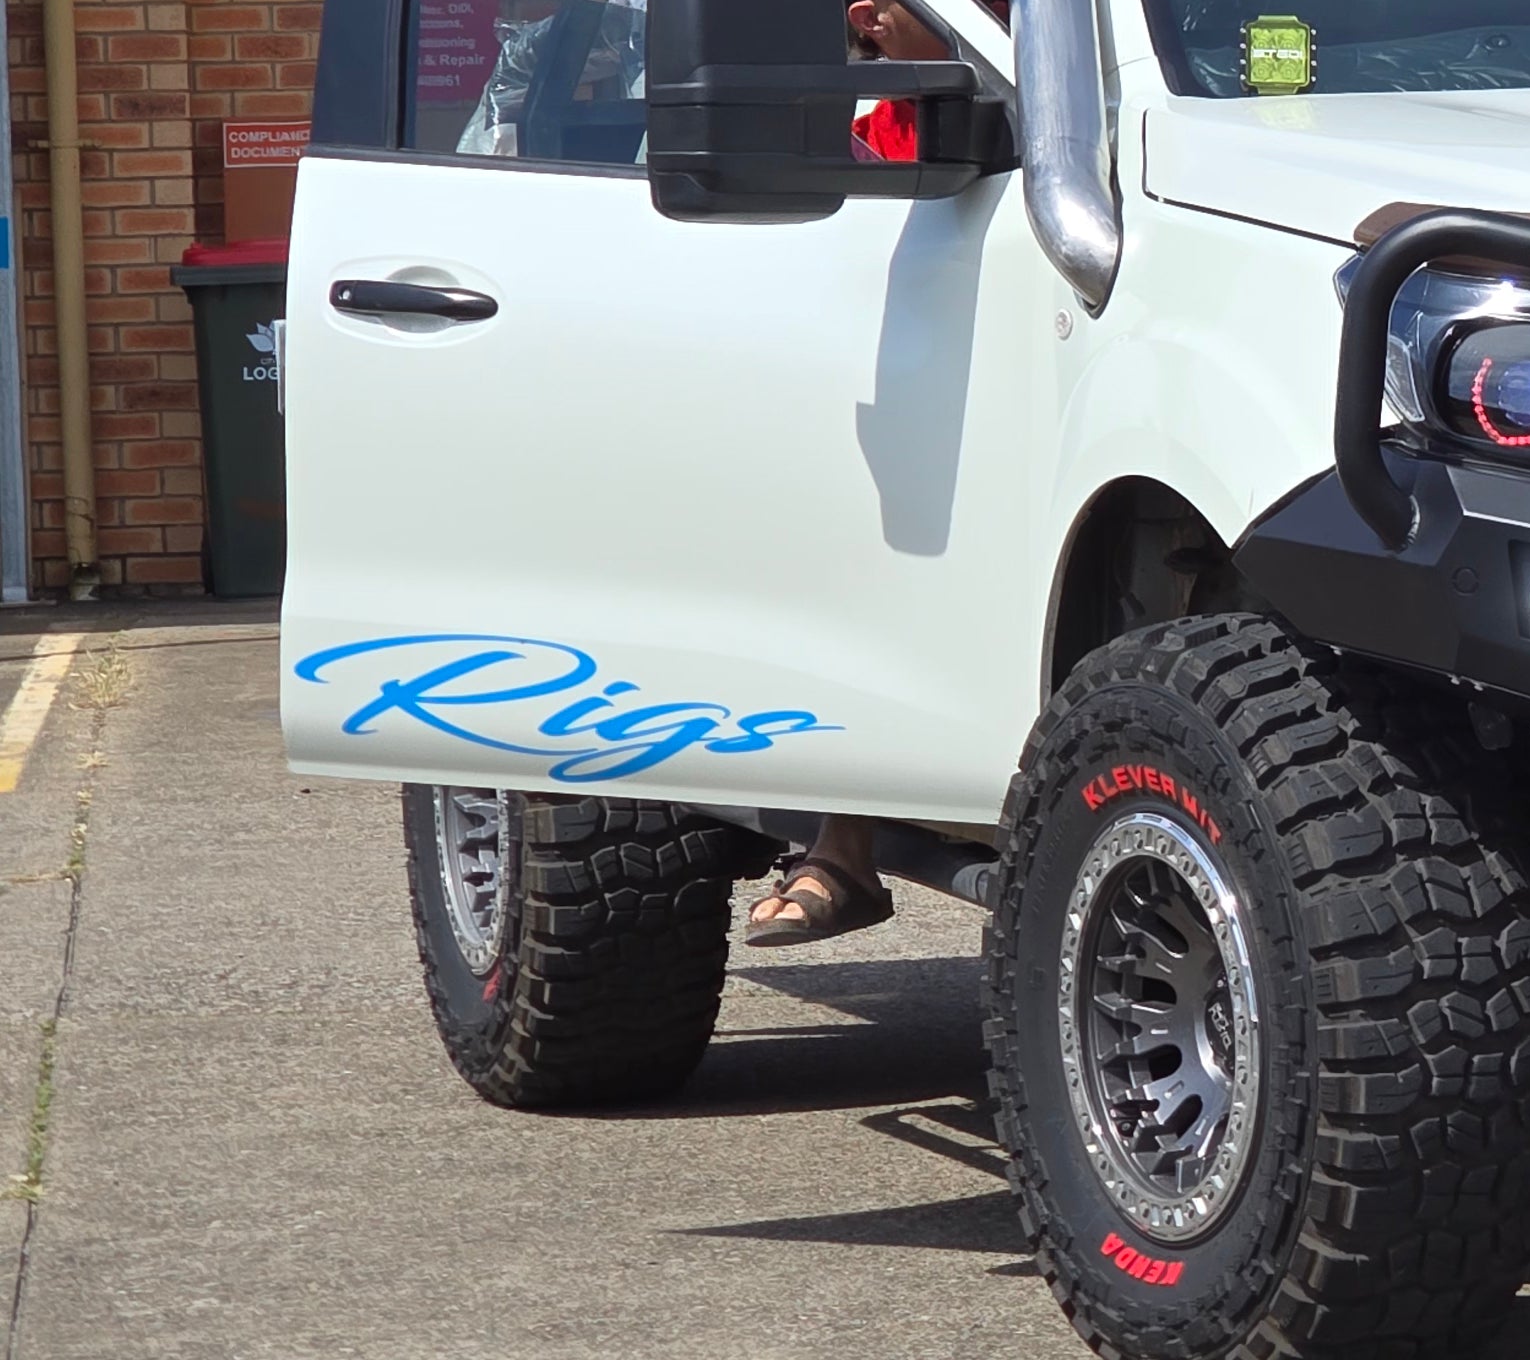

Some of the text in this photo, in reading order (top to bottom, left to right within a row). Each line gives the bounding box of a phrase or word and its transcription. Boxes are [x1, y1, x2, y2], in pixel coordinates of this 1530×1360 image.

[440, 53, 486, 67] Repair
[228, 129, 311, 143] COMPLIANC
[231, 146, 301, 158] DOCUMEN
[243, 366, 279, 381] LOG
[294, 633, 846, 783] Rigs
[1082, 764, 1178, 811] KLEVER
[1100, 1232, 1184, 1286] KENDA
